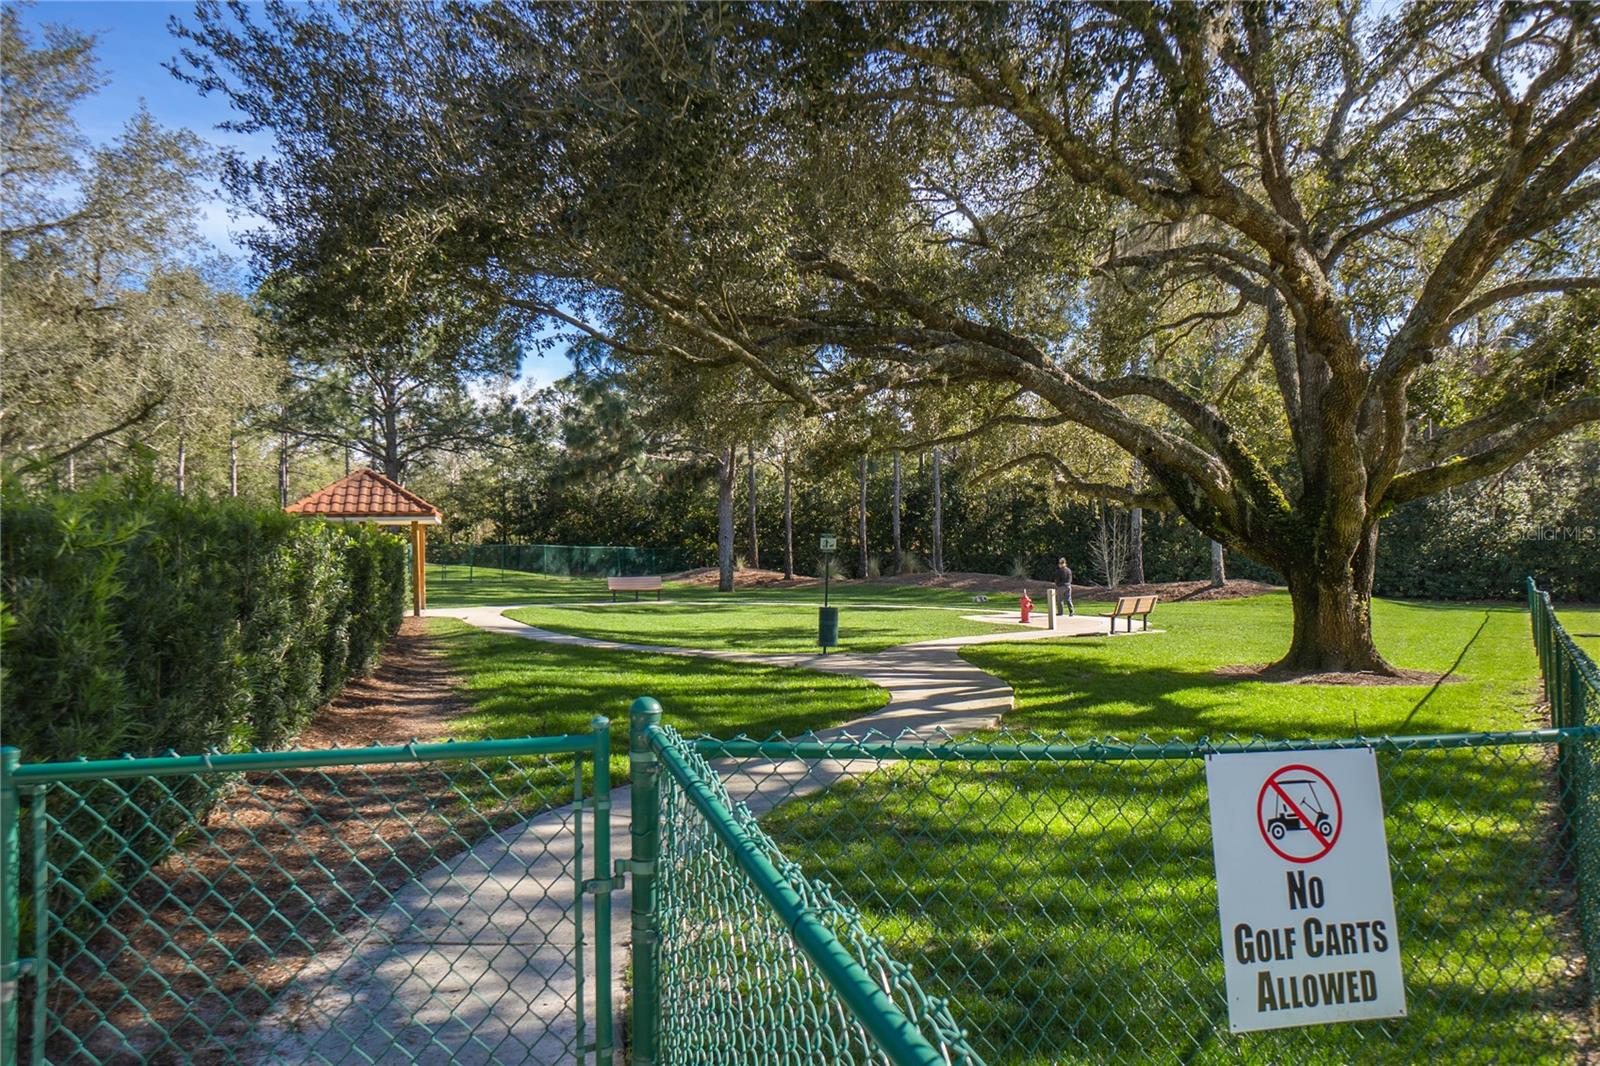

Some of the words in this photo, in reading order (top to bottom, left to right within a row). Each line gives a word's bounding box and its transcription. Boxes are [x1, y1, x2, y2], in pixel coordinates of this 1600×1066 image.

[1287, 870, 1325, 910] NO
[1235, 923, 1296, 964] GOLF
[1303, 917, 1388, 958] CARTS
[1257, 970, 1378, 1012] ALLOWED
